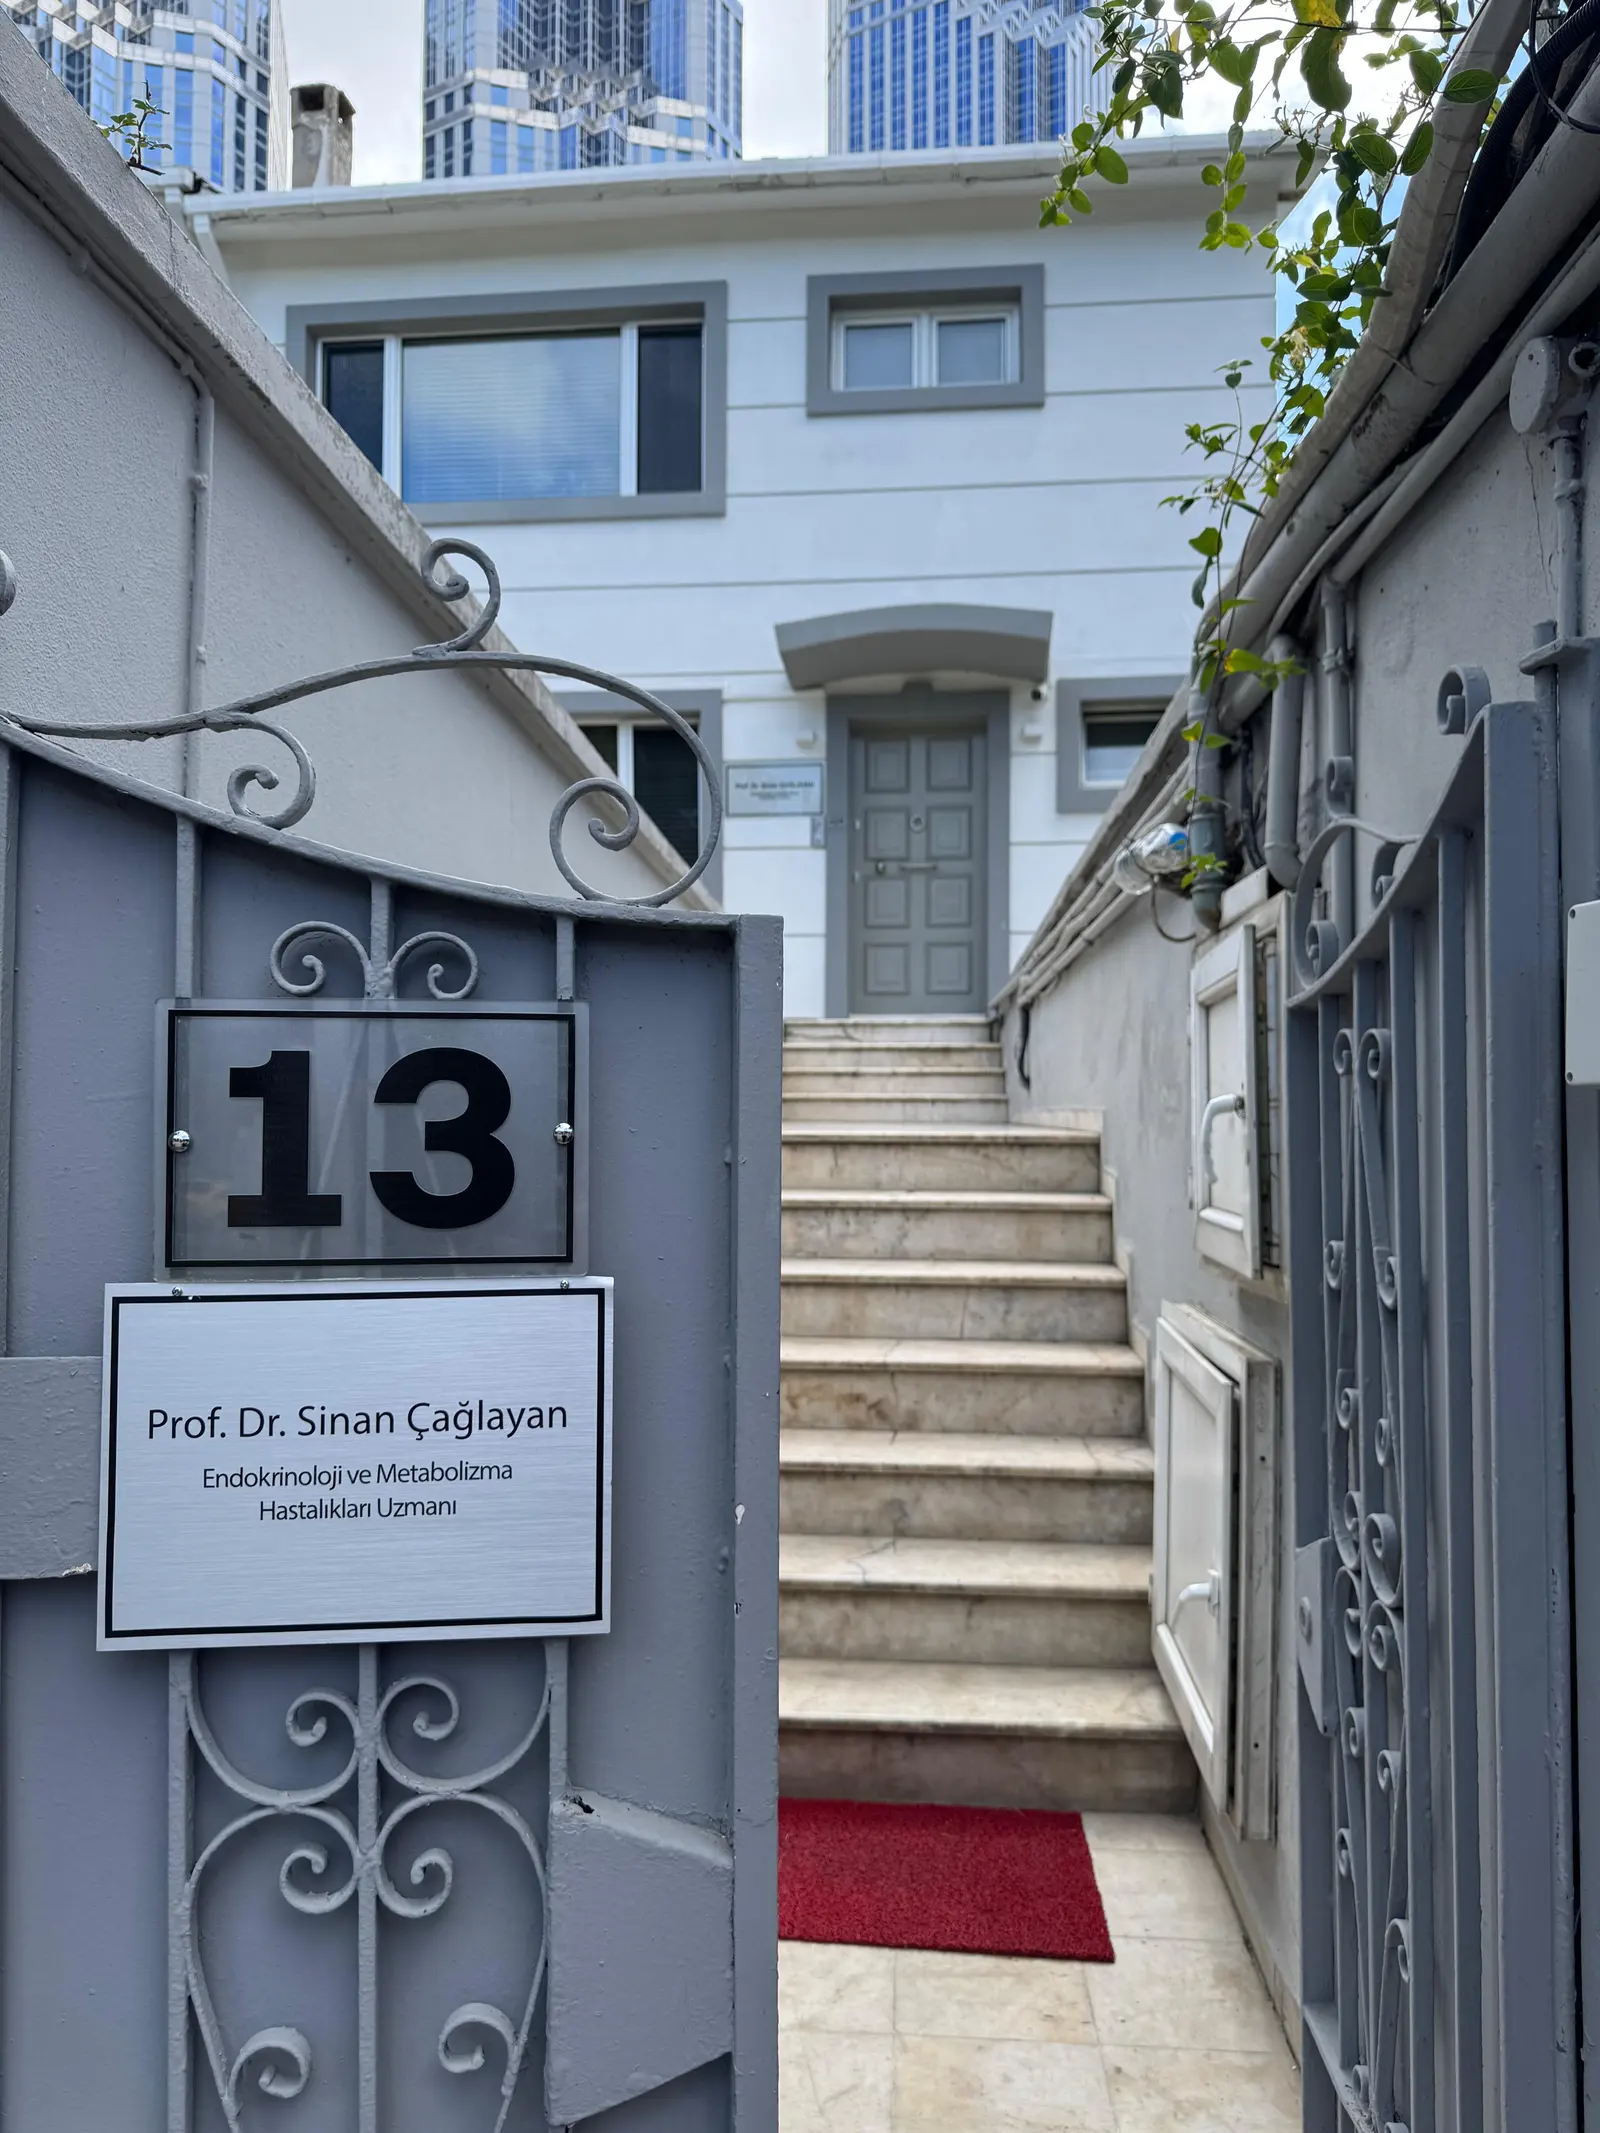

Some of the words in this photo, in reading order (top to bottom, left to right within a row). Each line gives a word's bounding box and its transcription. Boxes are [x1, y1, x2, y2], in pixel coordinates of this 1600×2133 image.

[227, 1047, 516, 1229] 13
[148, 1406, 227, 1440] Prof.
[239, 1407, 286, 1438] Dr.
[297, 1405, 395, 1437] Sinan
[407, 1400, 567, 1441] Çağlayan
[203, 1465, 343, 1491] Endokrinoloji
[346, 1469, 372, 1485] ve
[376, 1461, 513, 1484] Metabolizma
[259, 1498, 372, 1521] Hastalıkları
[377, 1498, 457, 1518] Uzmanı
